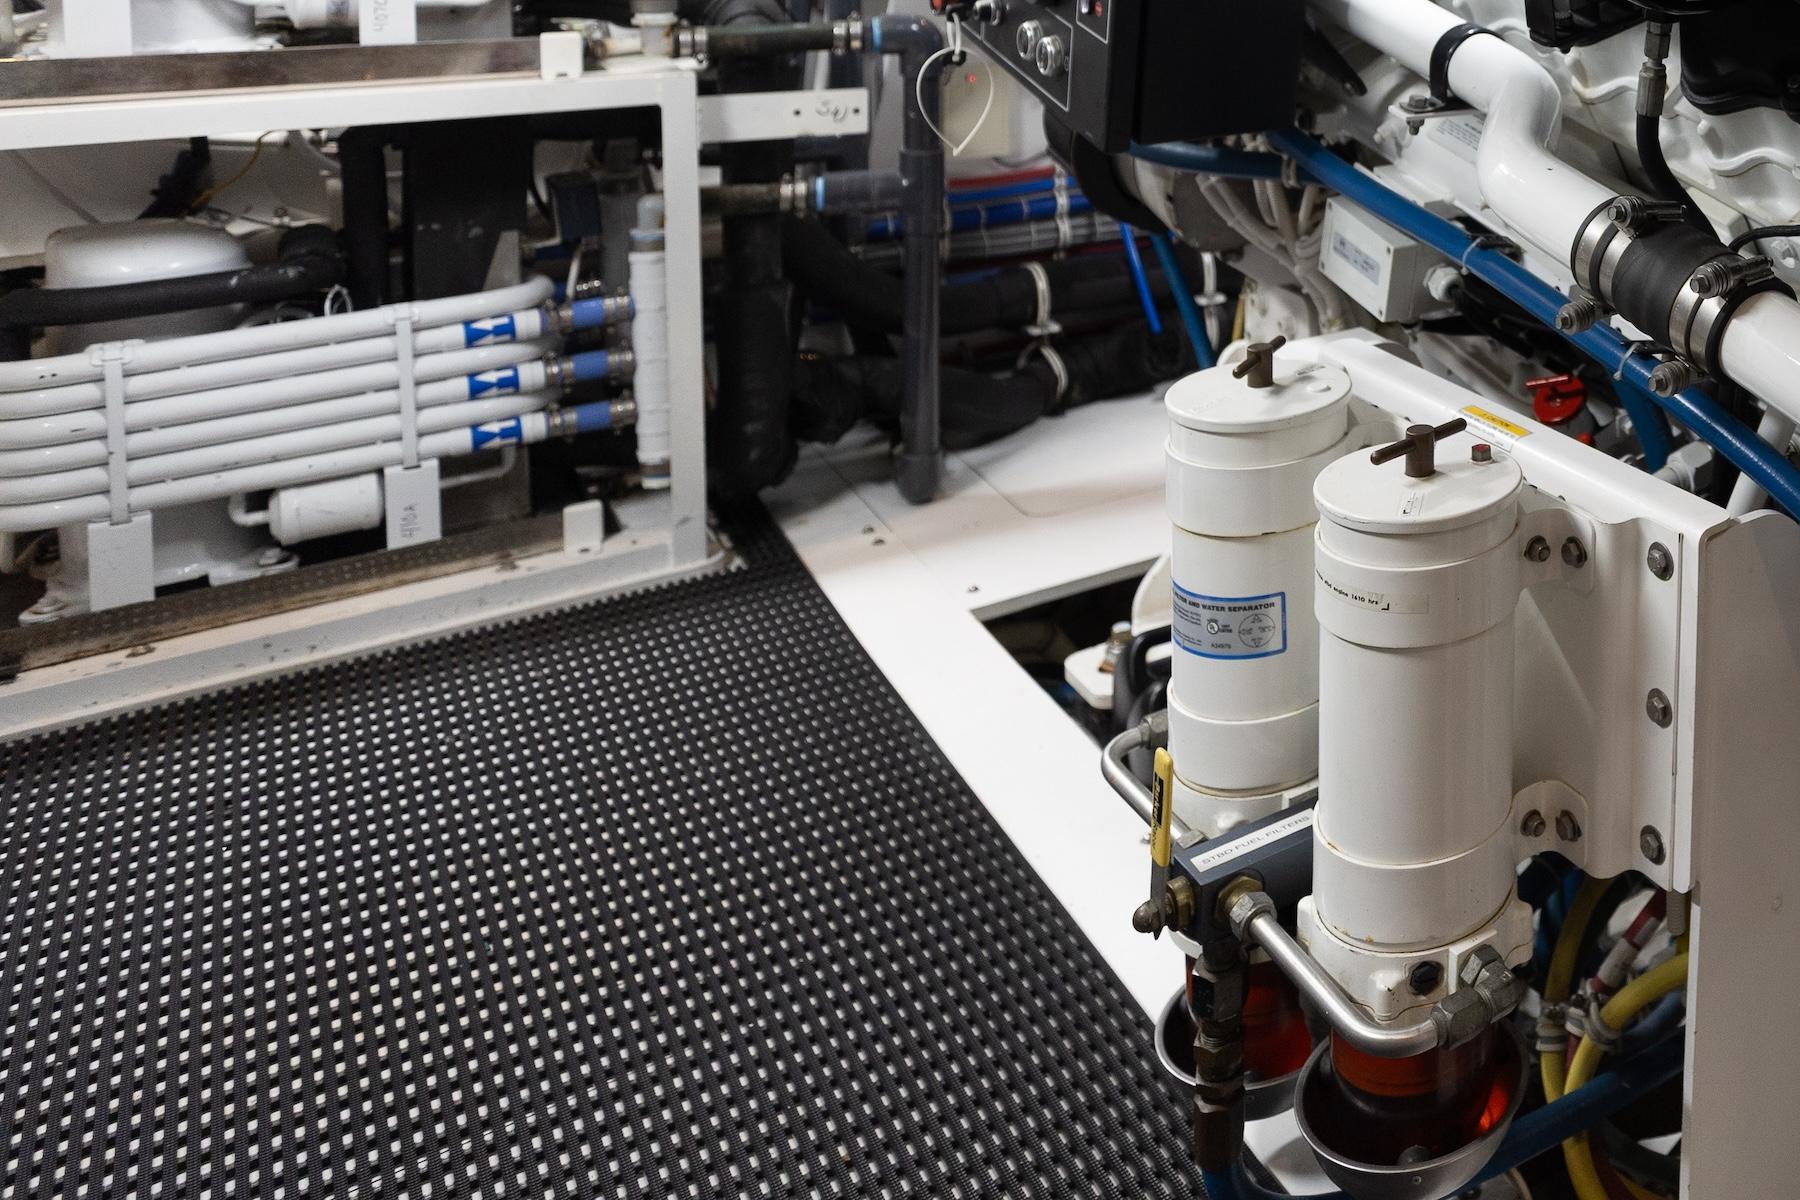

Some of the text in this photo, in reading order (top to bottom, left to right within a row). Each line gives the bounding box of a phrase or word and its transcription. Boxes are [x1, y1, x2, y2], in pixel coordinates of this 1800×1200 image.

[1188, 600, 1200, 609] AND
[1202, 604, 1226, 612] WATER
[1228, 602, 1275, 613] SEPARATOR
[1235, 834, 1265, 853] FUEL
[1265, 815, 1311, 839] FILTERS
